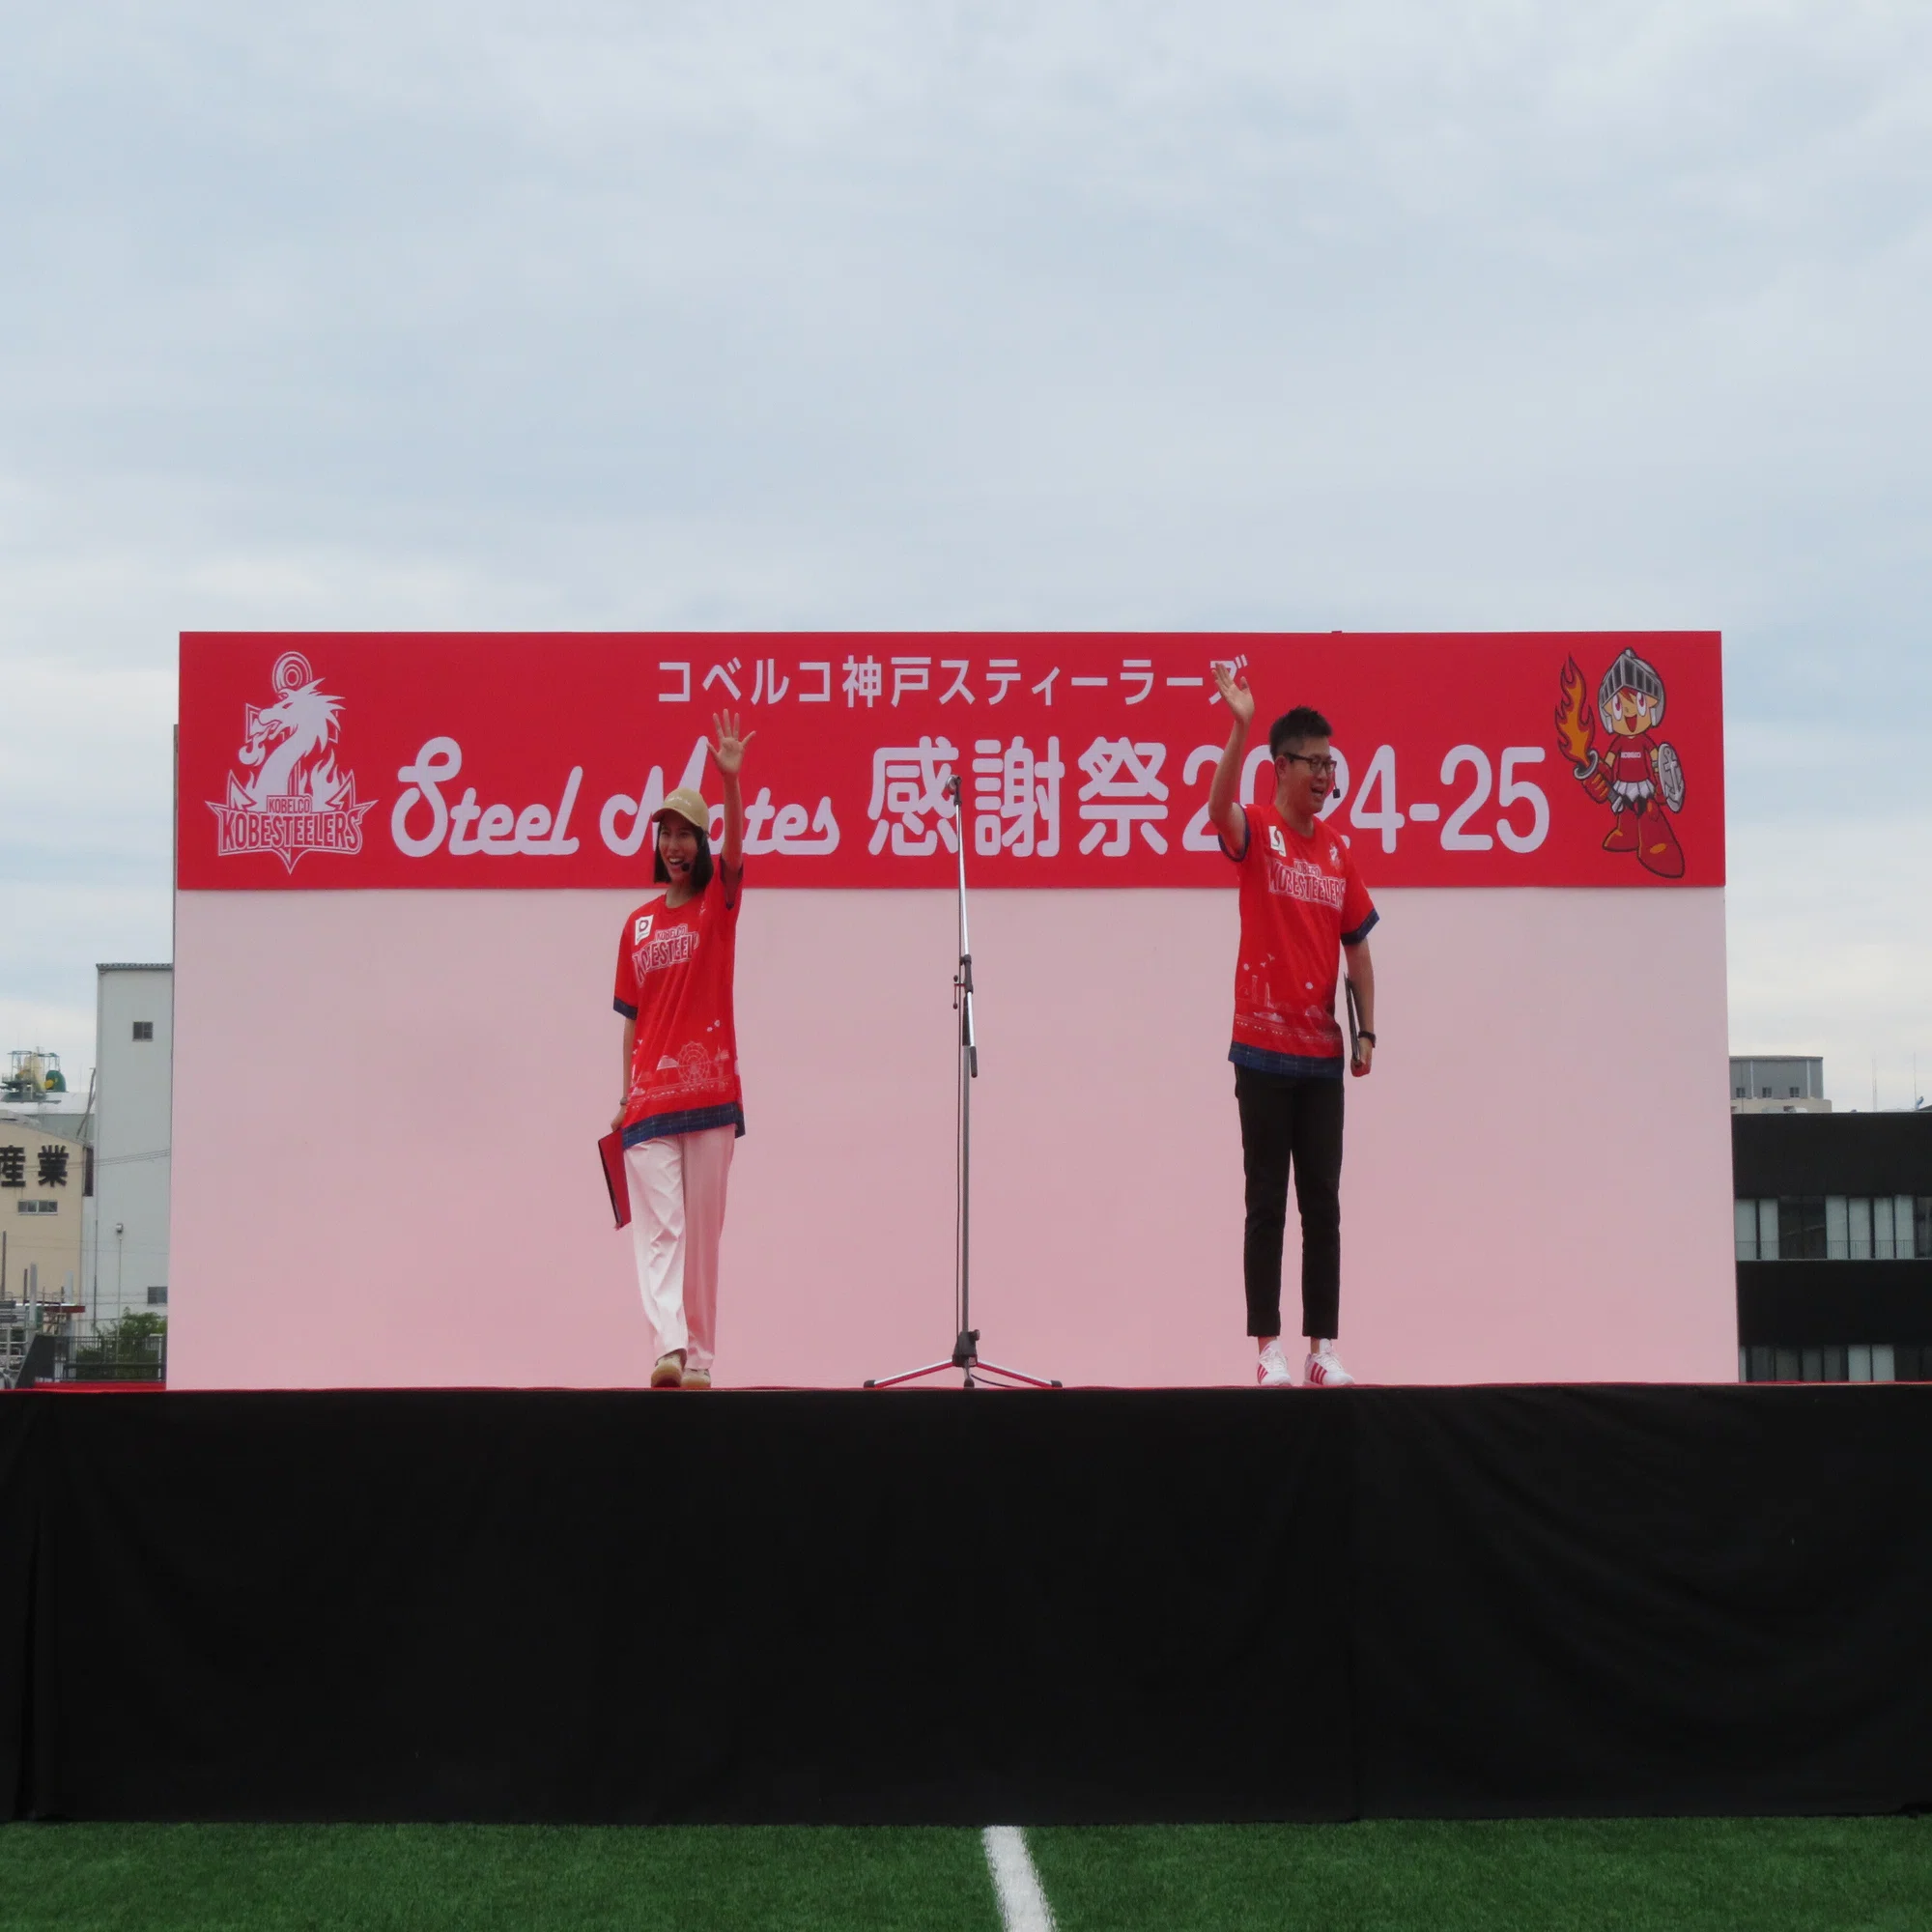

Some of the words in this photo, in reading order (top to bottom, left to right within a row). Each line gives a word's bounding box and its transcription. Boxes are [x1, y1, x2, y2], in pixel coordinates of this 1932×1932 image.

[658, 655, 1248, 708] コベルコ神戸スティーラーズ
[268, 797, 311, 813] KOBELCO
[390, 736, 583, 857] Steel
[222, 811, 362, 852] KOBESTEELERS
[0, 1145, 70, 1188] 産業
